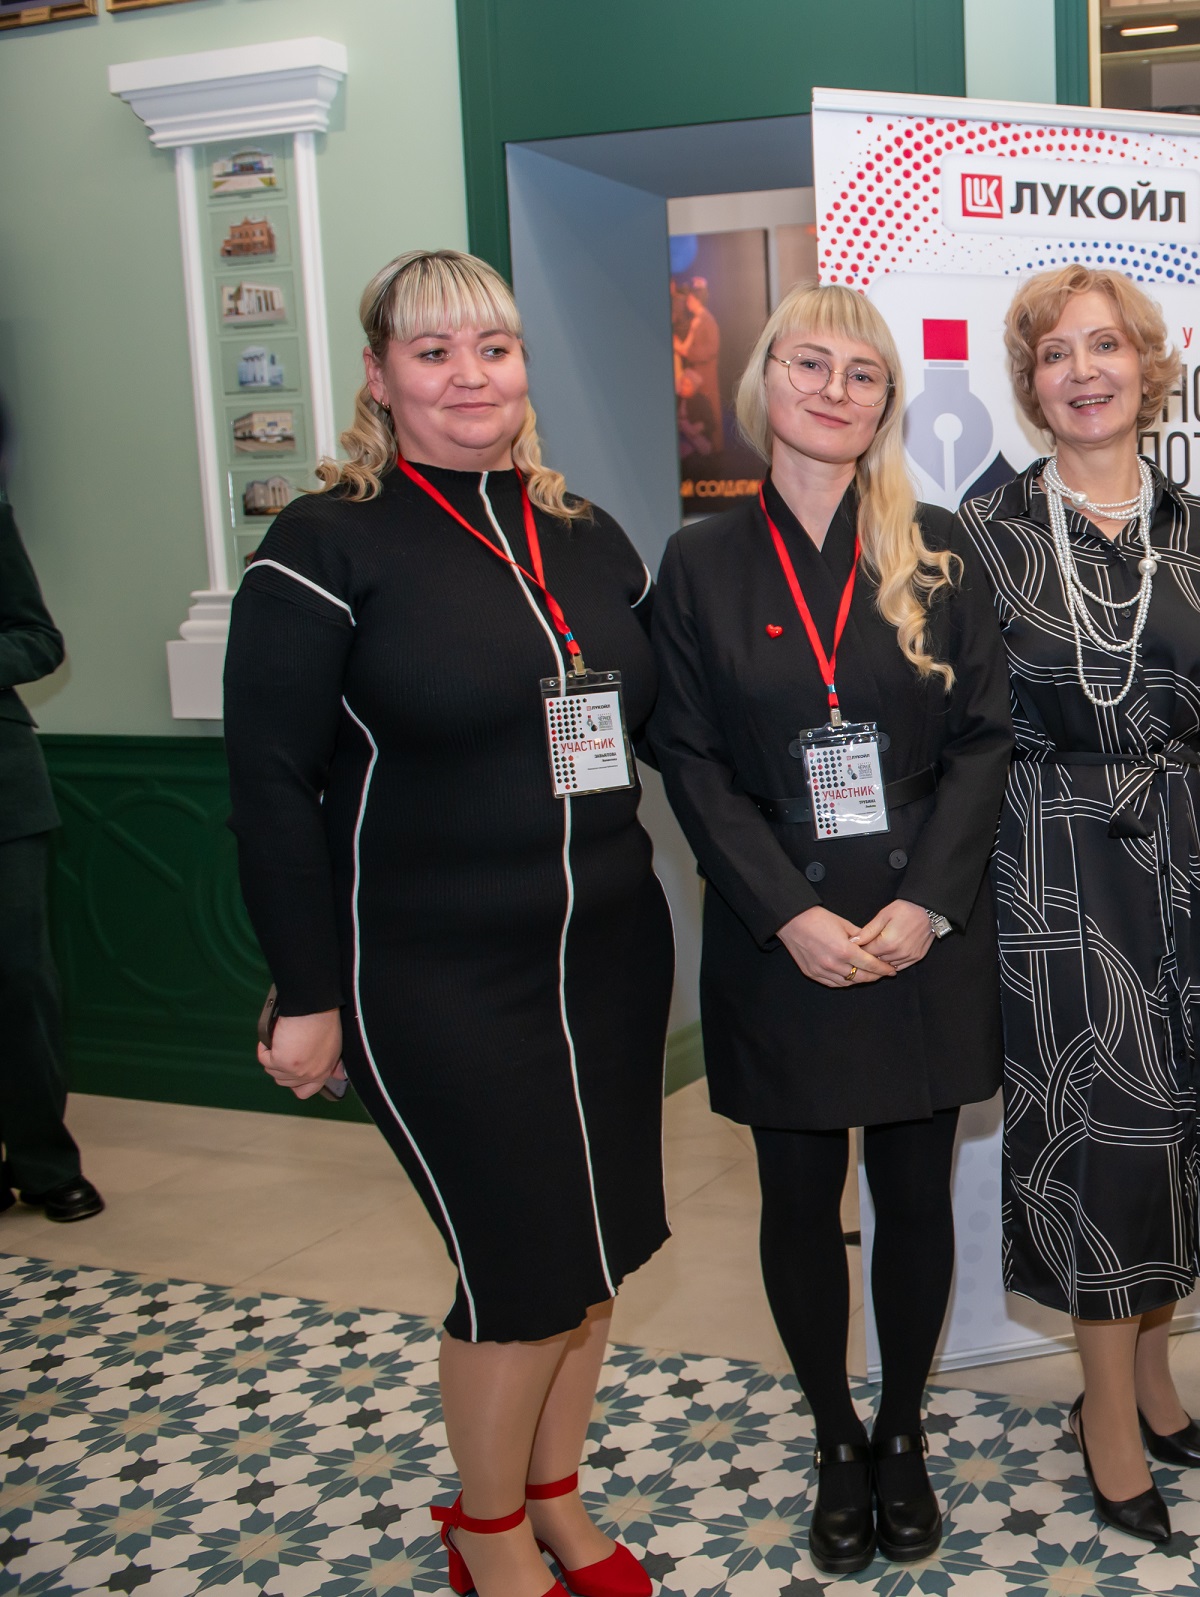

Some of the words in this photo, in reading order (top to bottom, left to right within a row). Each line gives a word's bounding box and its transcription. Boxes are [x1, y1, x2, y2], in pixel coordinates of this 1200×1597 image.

[1010, 180, 1186, 223] ЛУКОЙЛ
[561, 738, 615, 754] УЧАСТНИК
[822, 785, 875, 801] УЧАСТНИК
